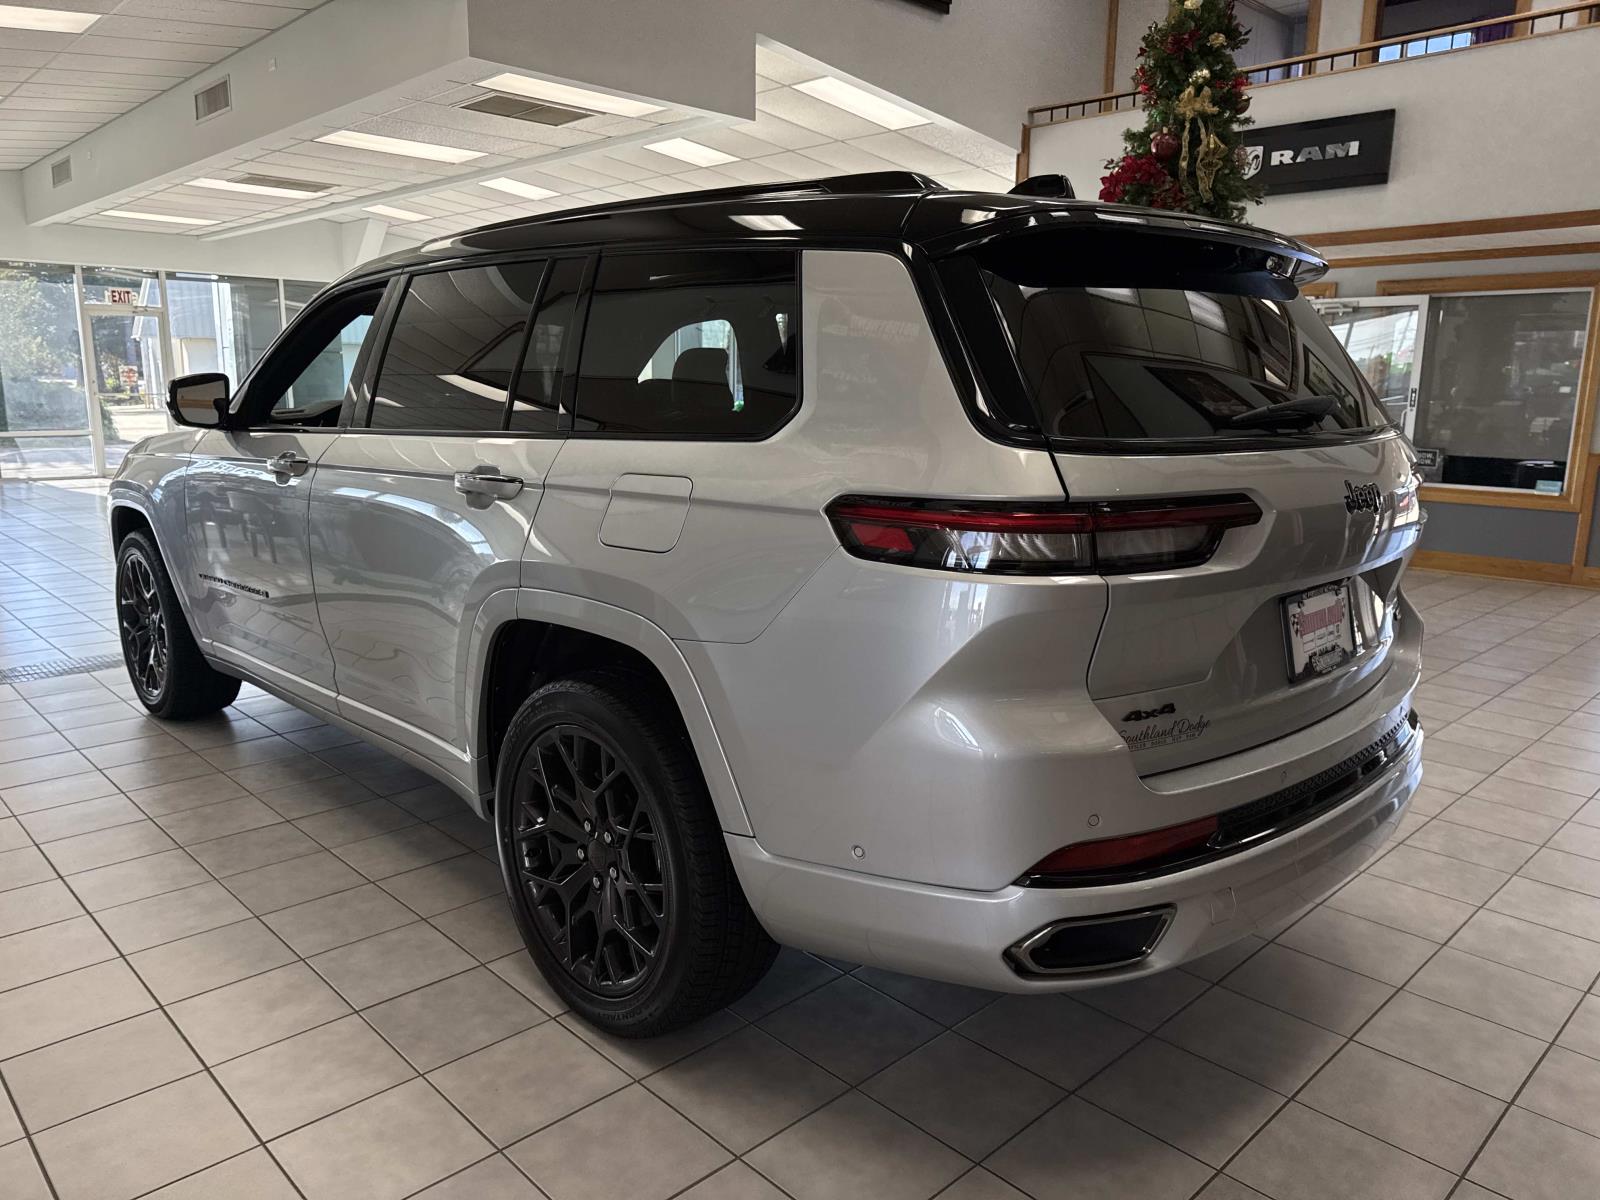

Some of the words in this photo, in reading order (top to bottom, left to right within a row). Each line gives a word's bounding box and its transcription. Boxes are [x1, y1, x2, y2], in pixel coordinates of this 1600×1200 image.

[1270, 140, 1360, 166] RAM
[111, 290, 131, 304] EXIT
[1343, 480, 1381, 515] Jeep
[1121, 702, 1176, 722] 4x4
[1120, 720, 1178, 744] Southland
